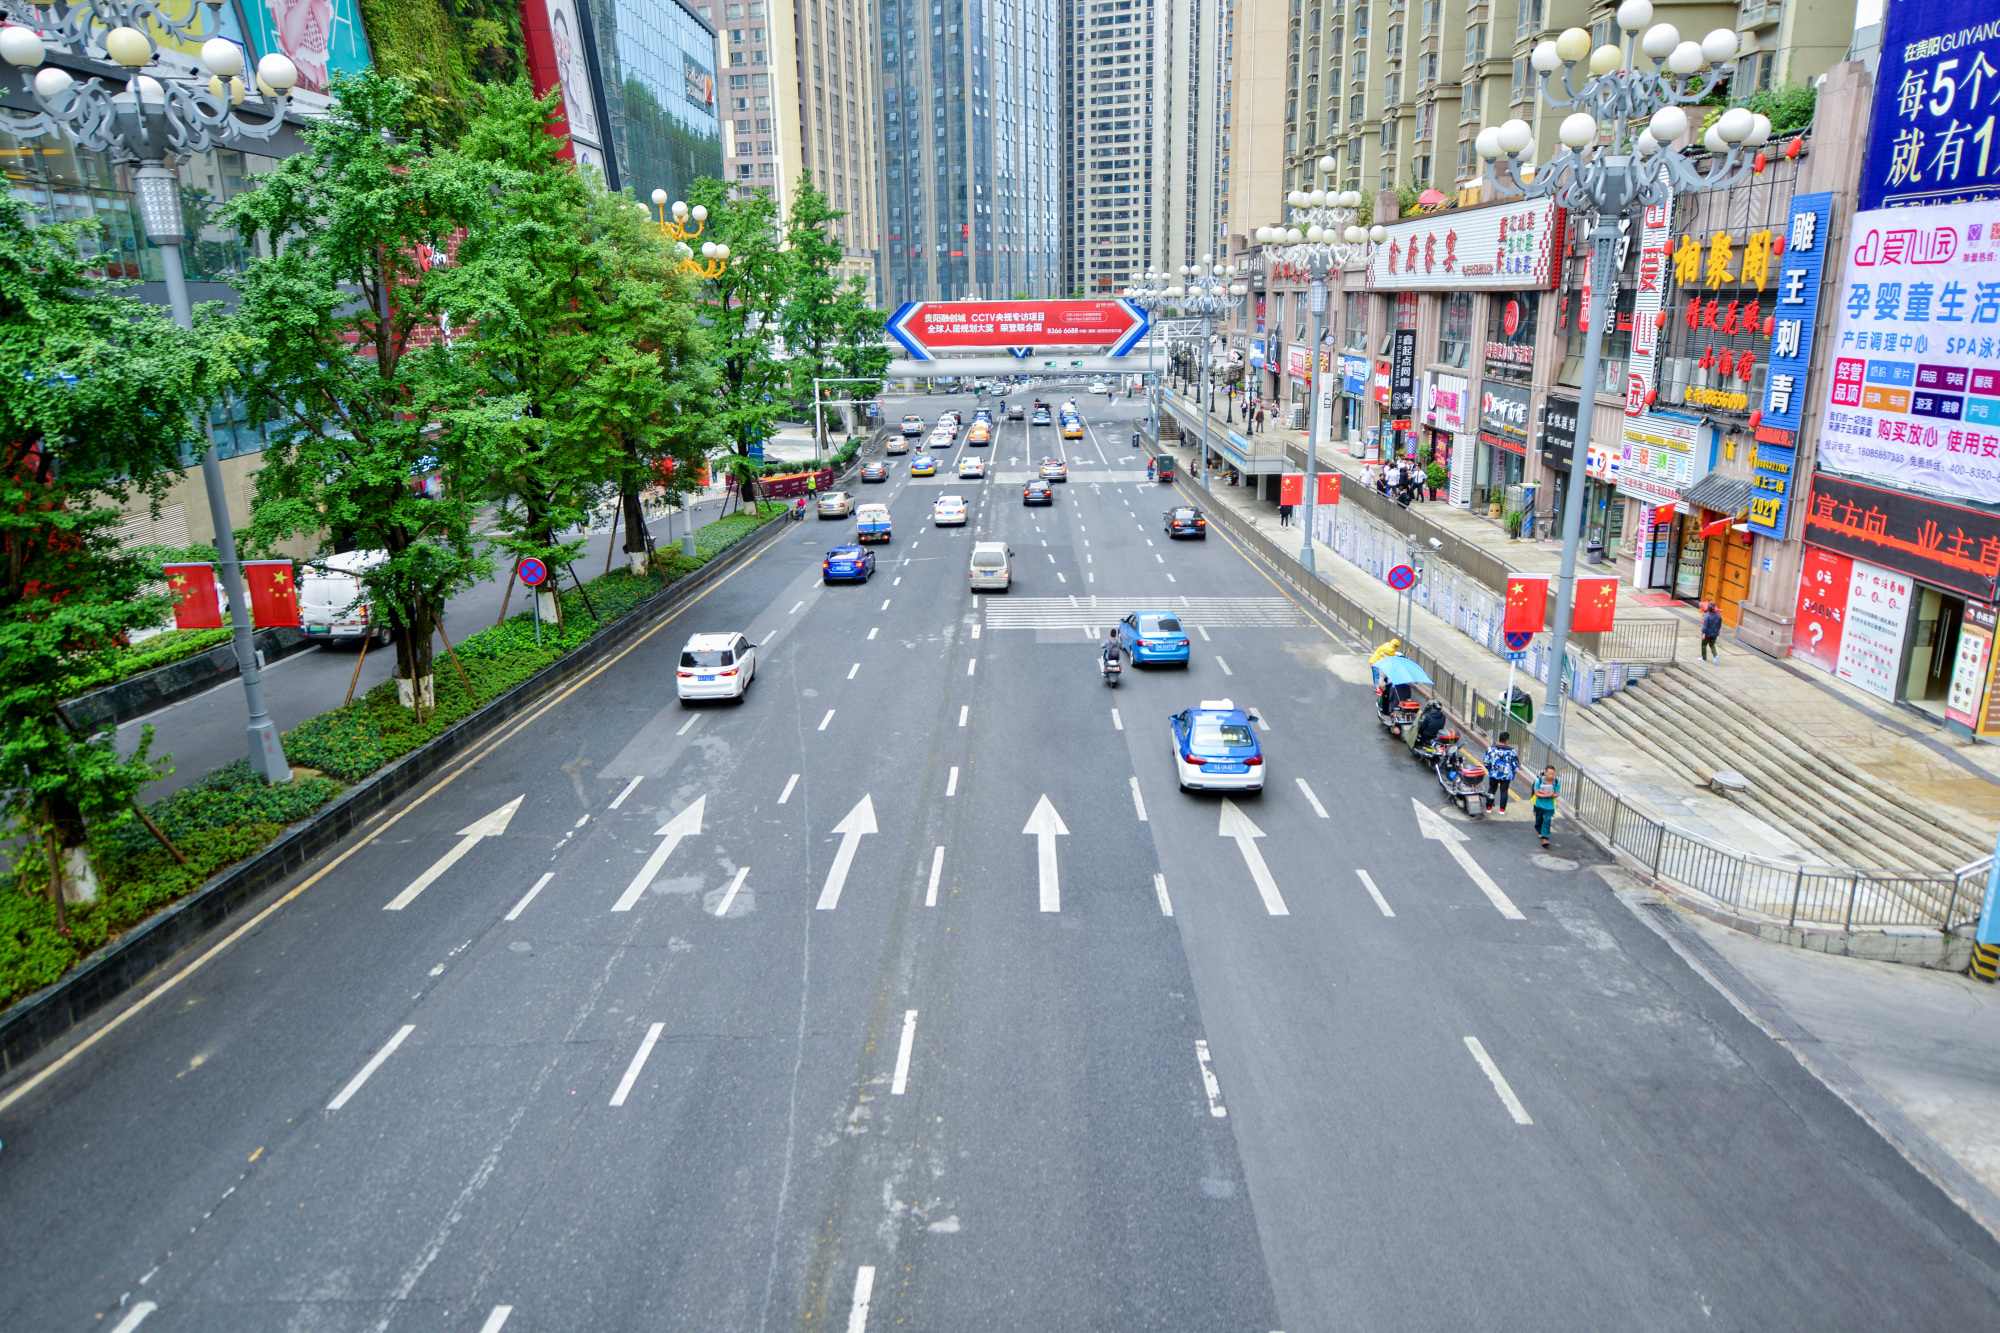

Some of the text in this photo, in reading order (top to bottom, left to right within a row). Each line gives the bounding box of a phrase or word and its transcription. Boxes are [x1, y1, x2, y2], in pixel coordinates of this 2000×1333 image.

[1884, 114, 2000, 188] 就有1
[1769, 211, 1817, 413] 雕王刺青
[1847, 280, 2000, 324] 孕婴童生活
[1842, 331, 2000, 359] 产后调理中心 SPA泳
[1400, 335, 1413, 387] 鑫起点网咖
[1837, 362, 1863, 381] 经营
[1919, 370, 1938, 383] 用品
[1829, 411, 1873, 427] 我们的一切货品
[1969, 404, 1989, 418] 产后
[1877, 419, 2000, 458] 购买放心 使用安
[1753, 474, 1785, 494] 请上二楼
[1750, 497, 1771, 516] 202
[1817, 570, 1832, 584] 0元
